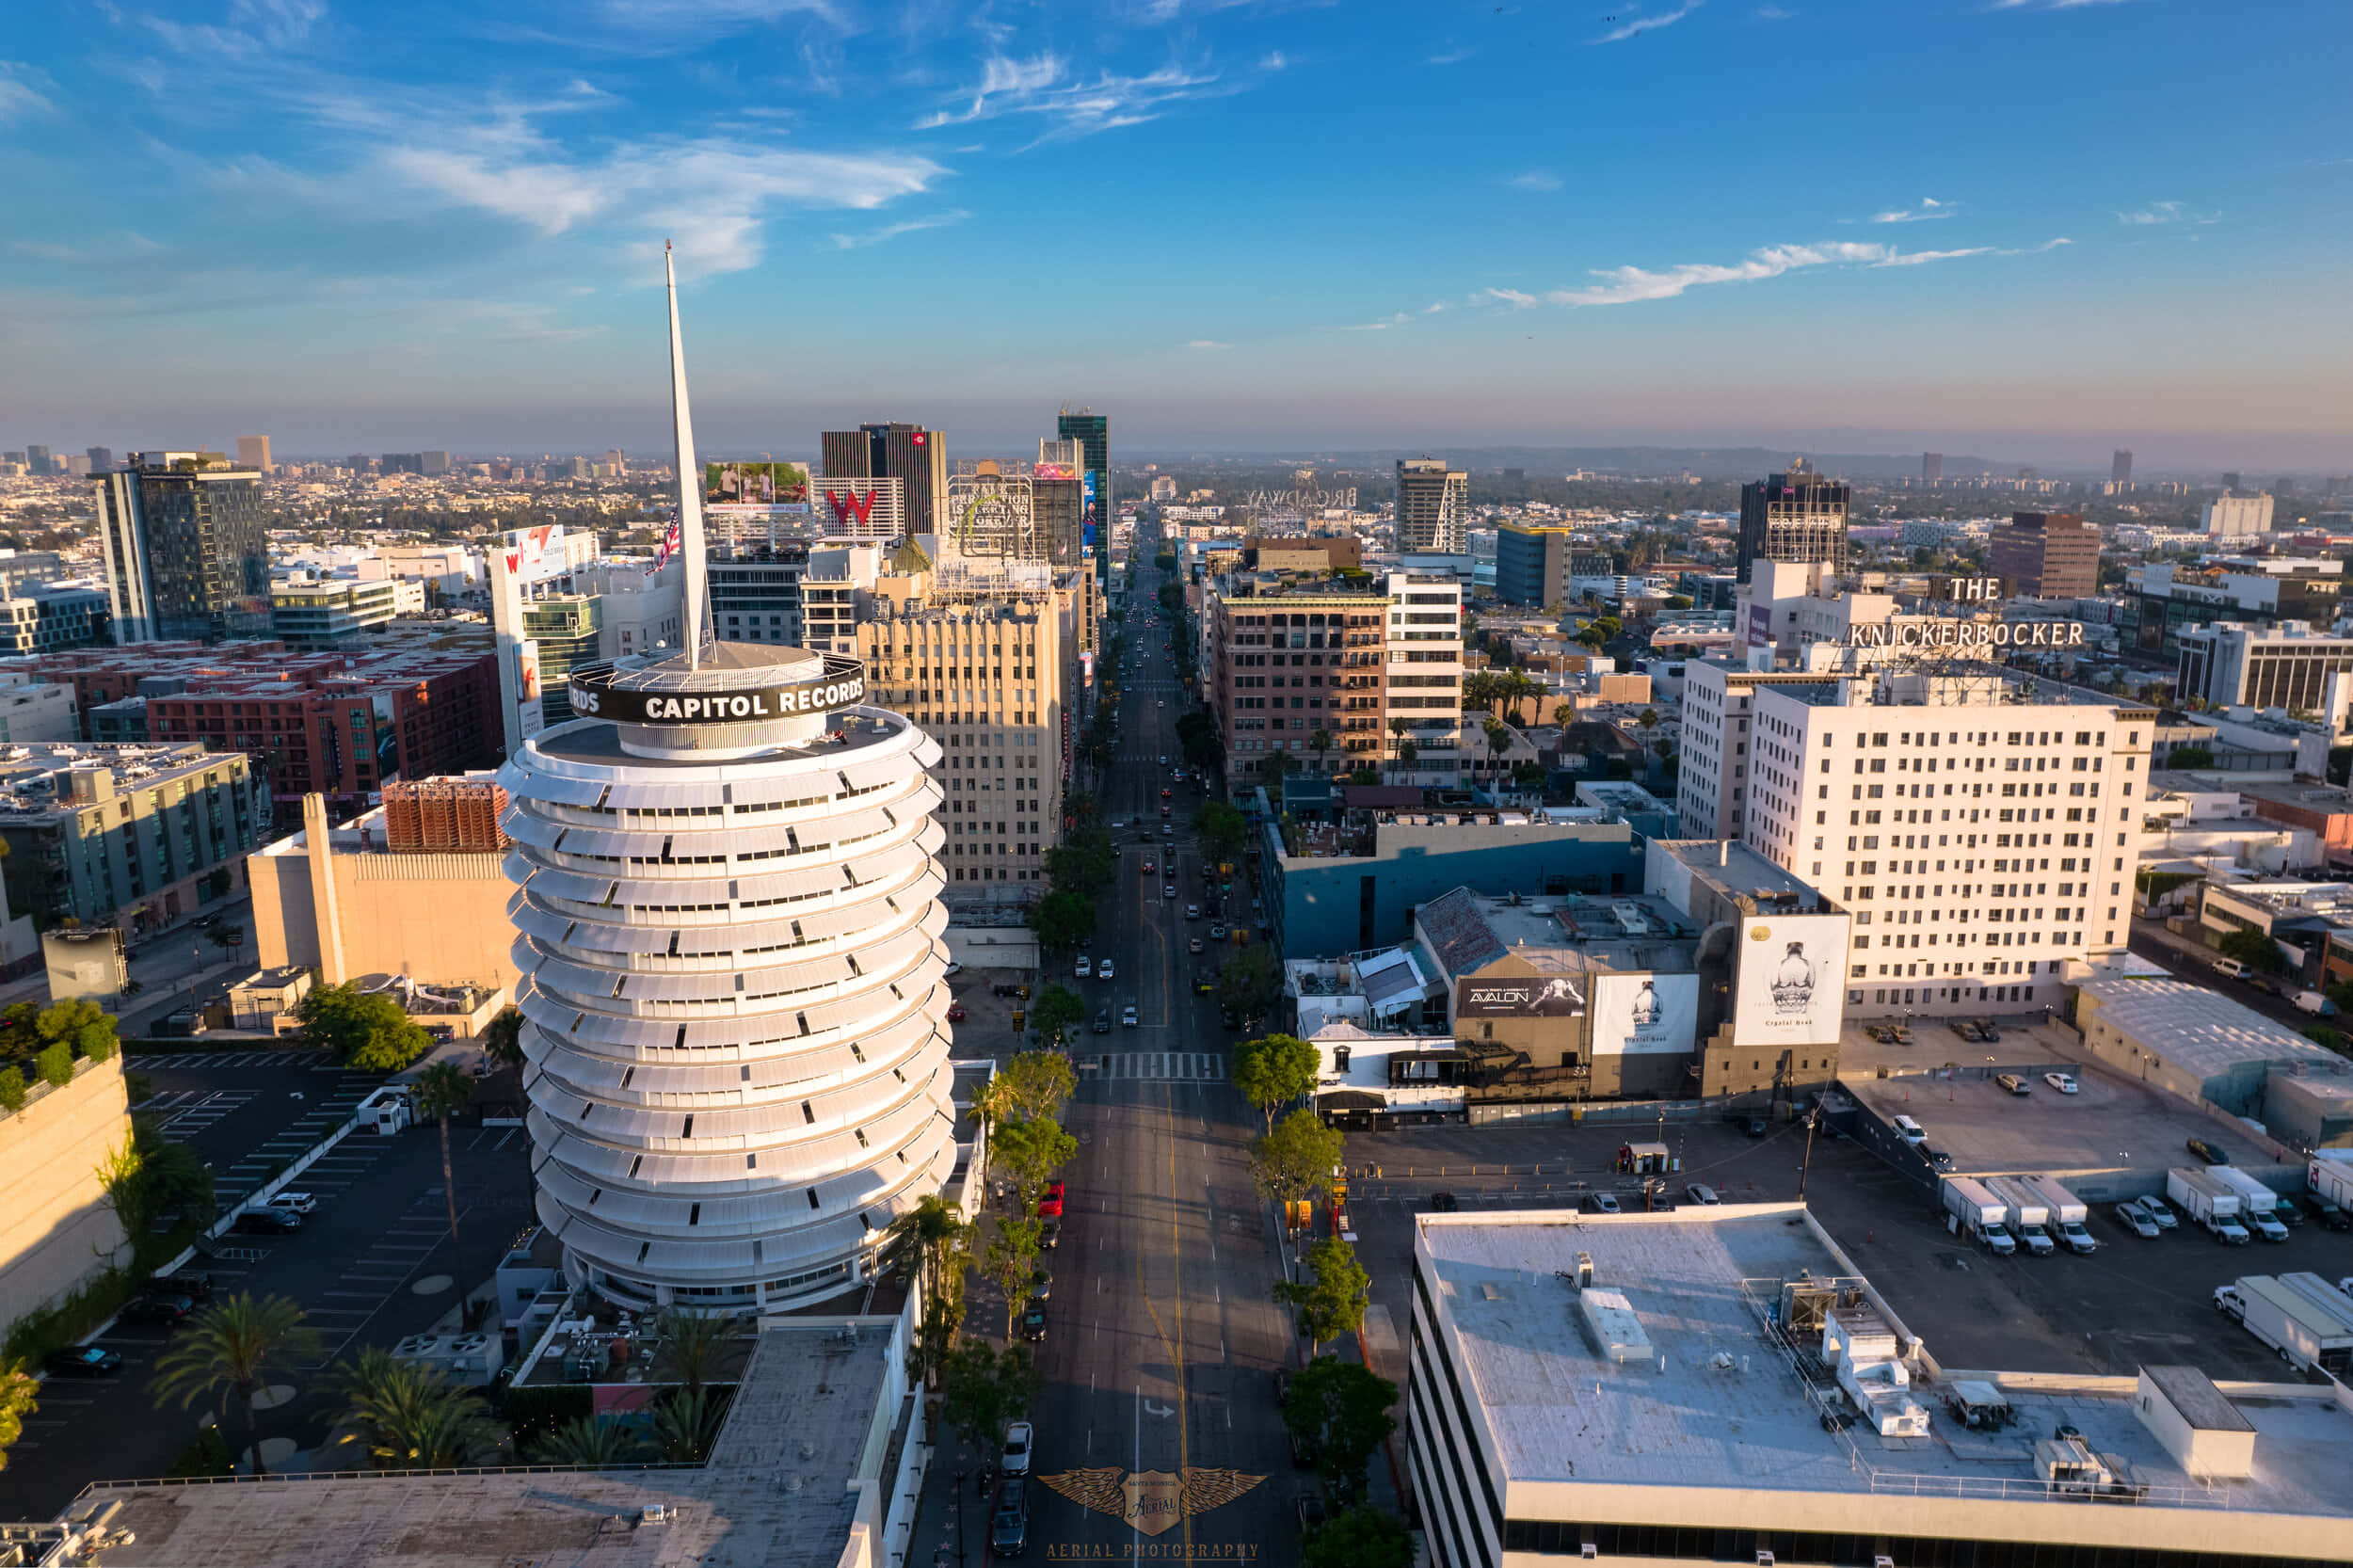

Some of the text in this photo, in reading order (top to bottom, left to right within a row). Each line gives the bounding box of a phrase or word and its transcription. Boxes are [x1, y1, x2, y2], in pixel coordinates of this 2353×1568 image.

[826, 490, 876, 527] W
[505, 553, 519, 574] W
[1948, 578, 1999, 600] THE
[1849, 623, 2084, 647] KNICKERBOCKER
[645, 696, 768, 718] CAPITOL
[779, 679, 863, 712] RECORDS
[1469, 992, 1529, 1002] AVALON
